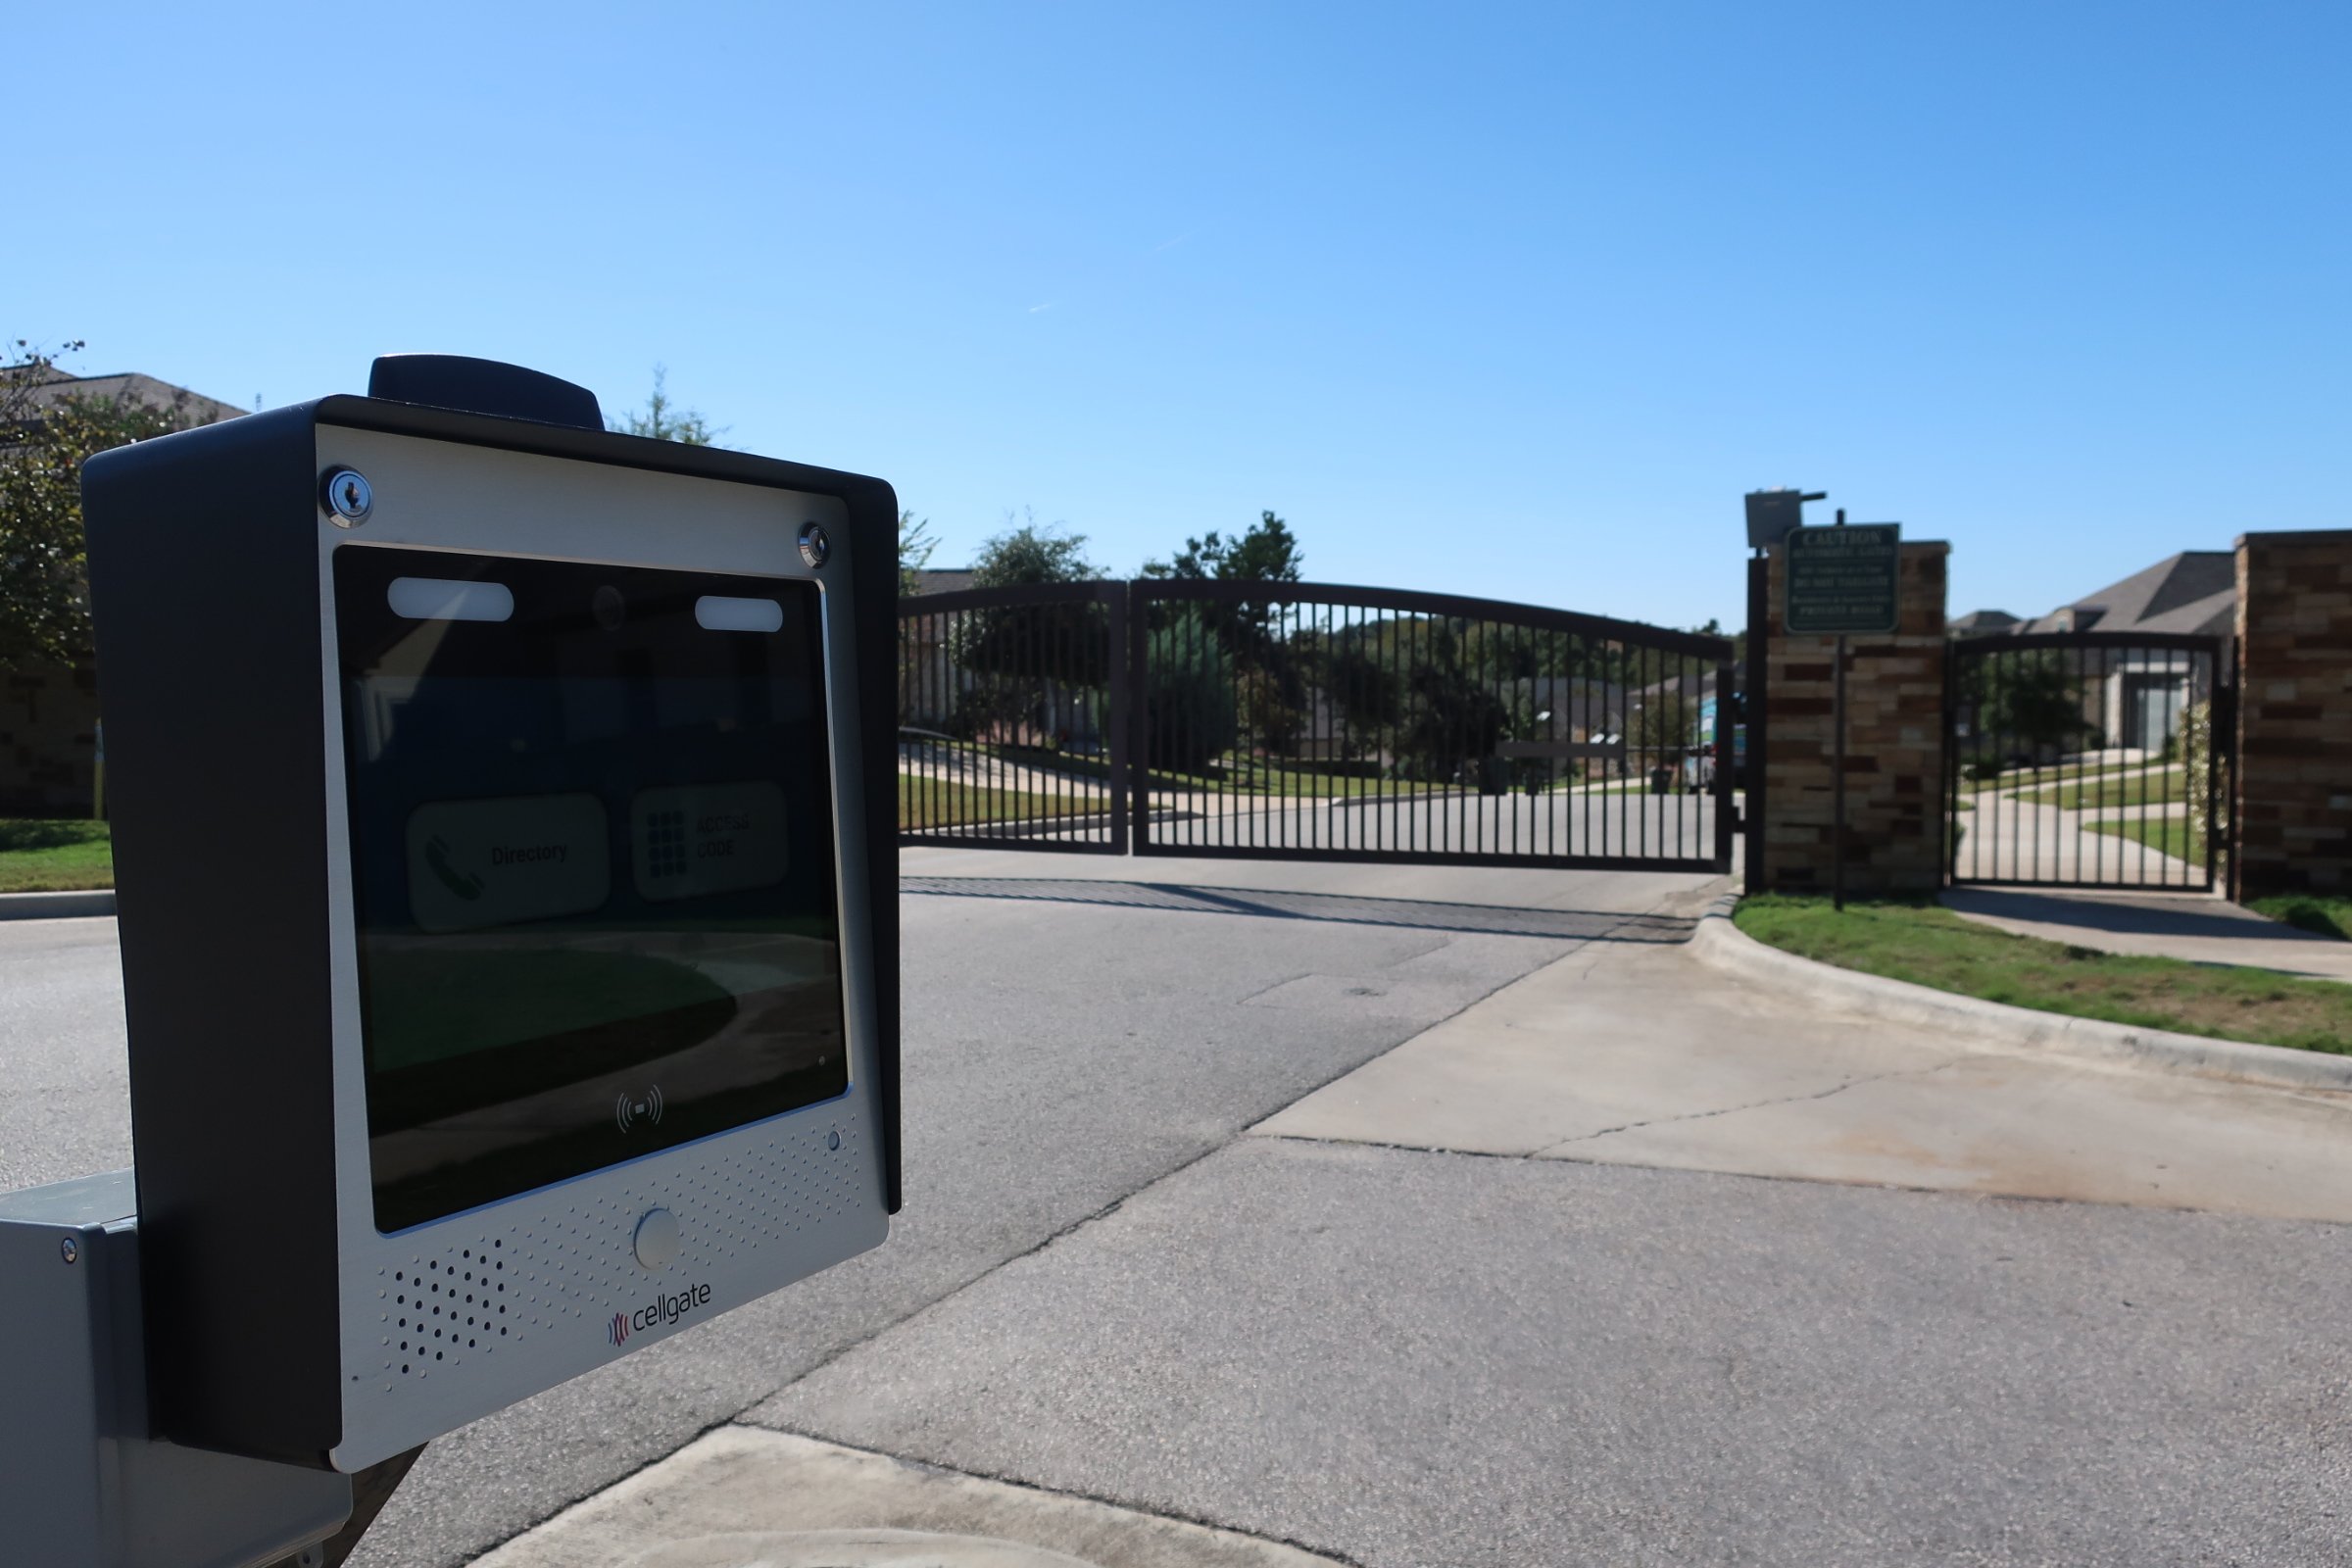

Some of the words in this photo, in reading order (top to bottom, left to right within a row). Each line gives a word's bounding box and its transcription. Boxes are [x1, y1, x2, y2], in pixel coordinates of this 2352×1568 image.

[1802, 531, 1882, 545] CAUTION
[696, 812, 750, 833] ACCESS
[491, 844, 567, 865] Directory
[697, 838, 735, 858] CODE
[633, 1283, 710, 1331] cellgate
